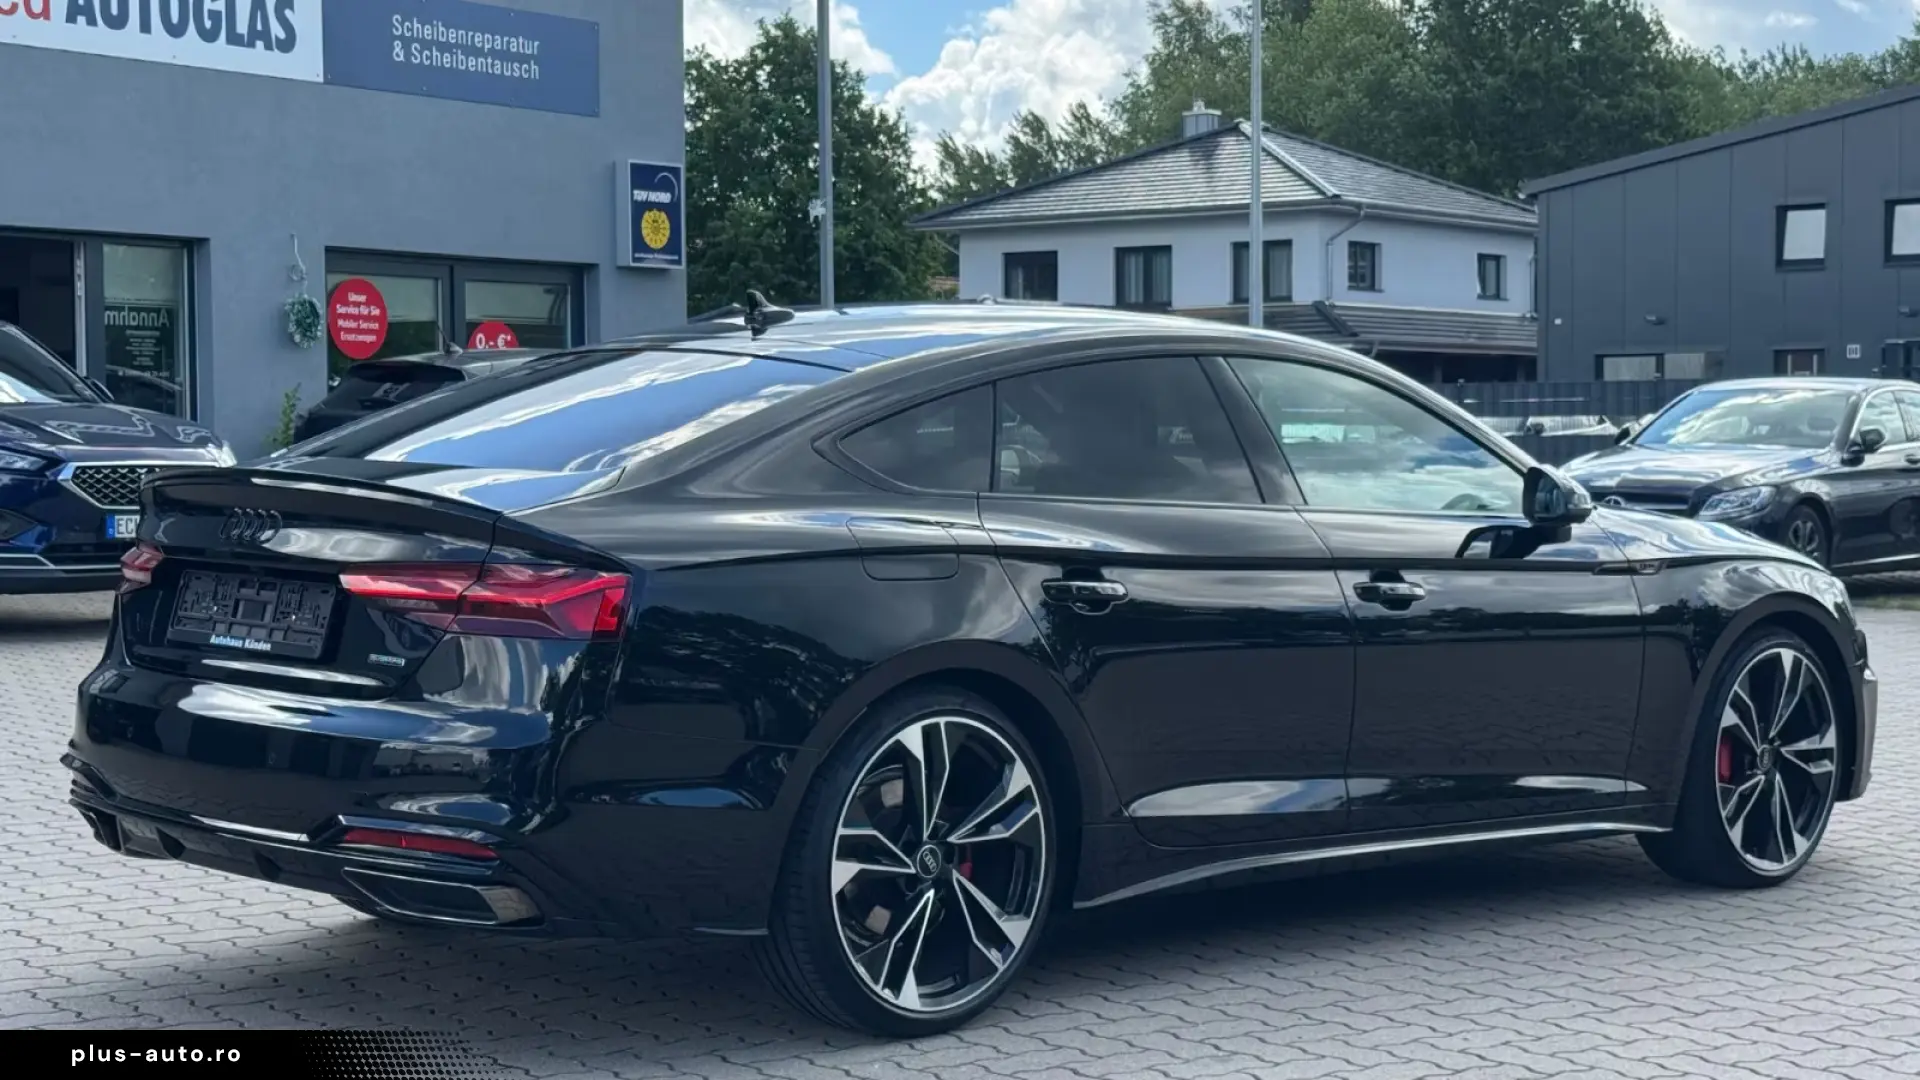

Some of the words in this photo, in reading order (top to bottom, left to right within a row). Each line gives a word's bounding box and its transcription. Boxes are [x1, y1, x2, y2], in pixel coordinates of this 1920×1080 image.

[392, 14, 540, 55] Scheibenreparatur
[392, 40, 405, 62] &
[411, 43, 540, 80] Scheibentausch
[647, 191, 672, 204] NORD
